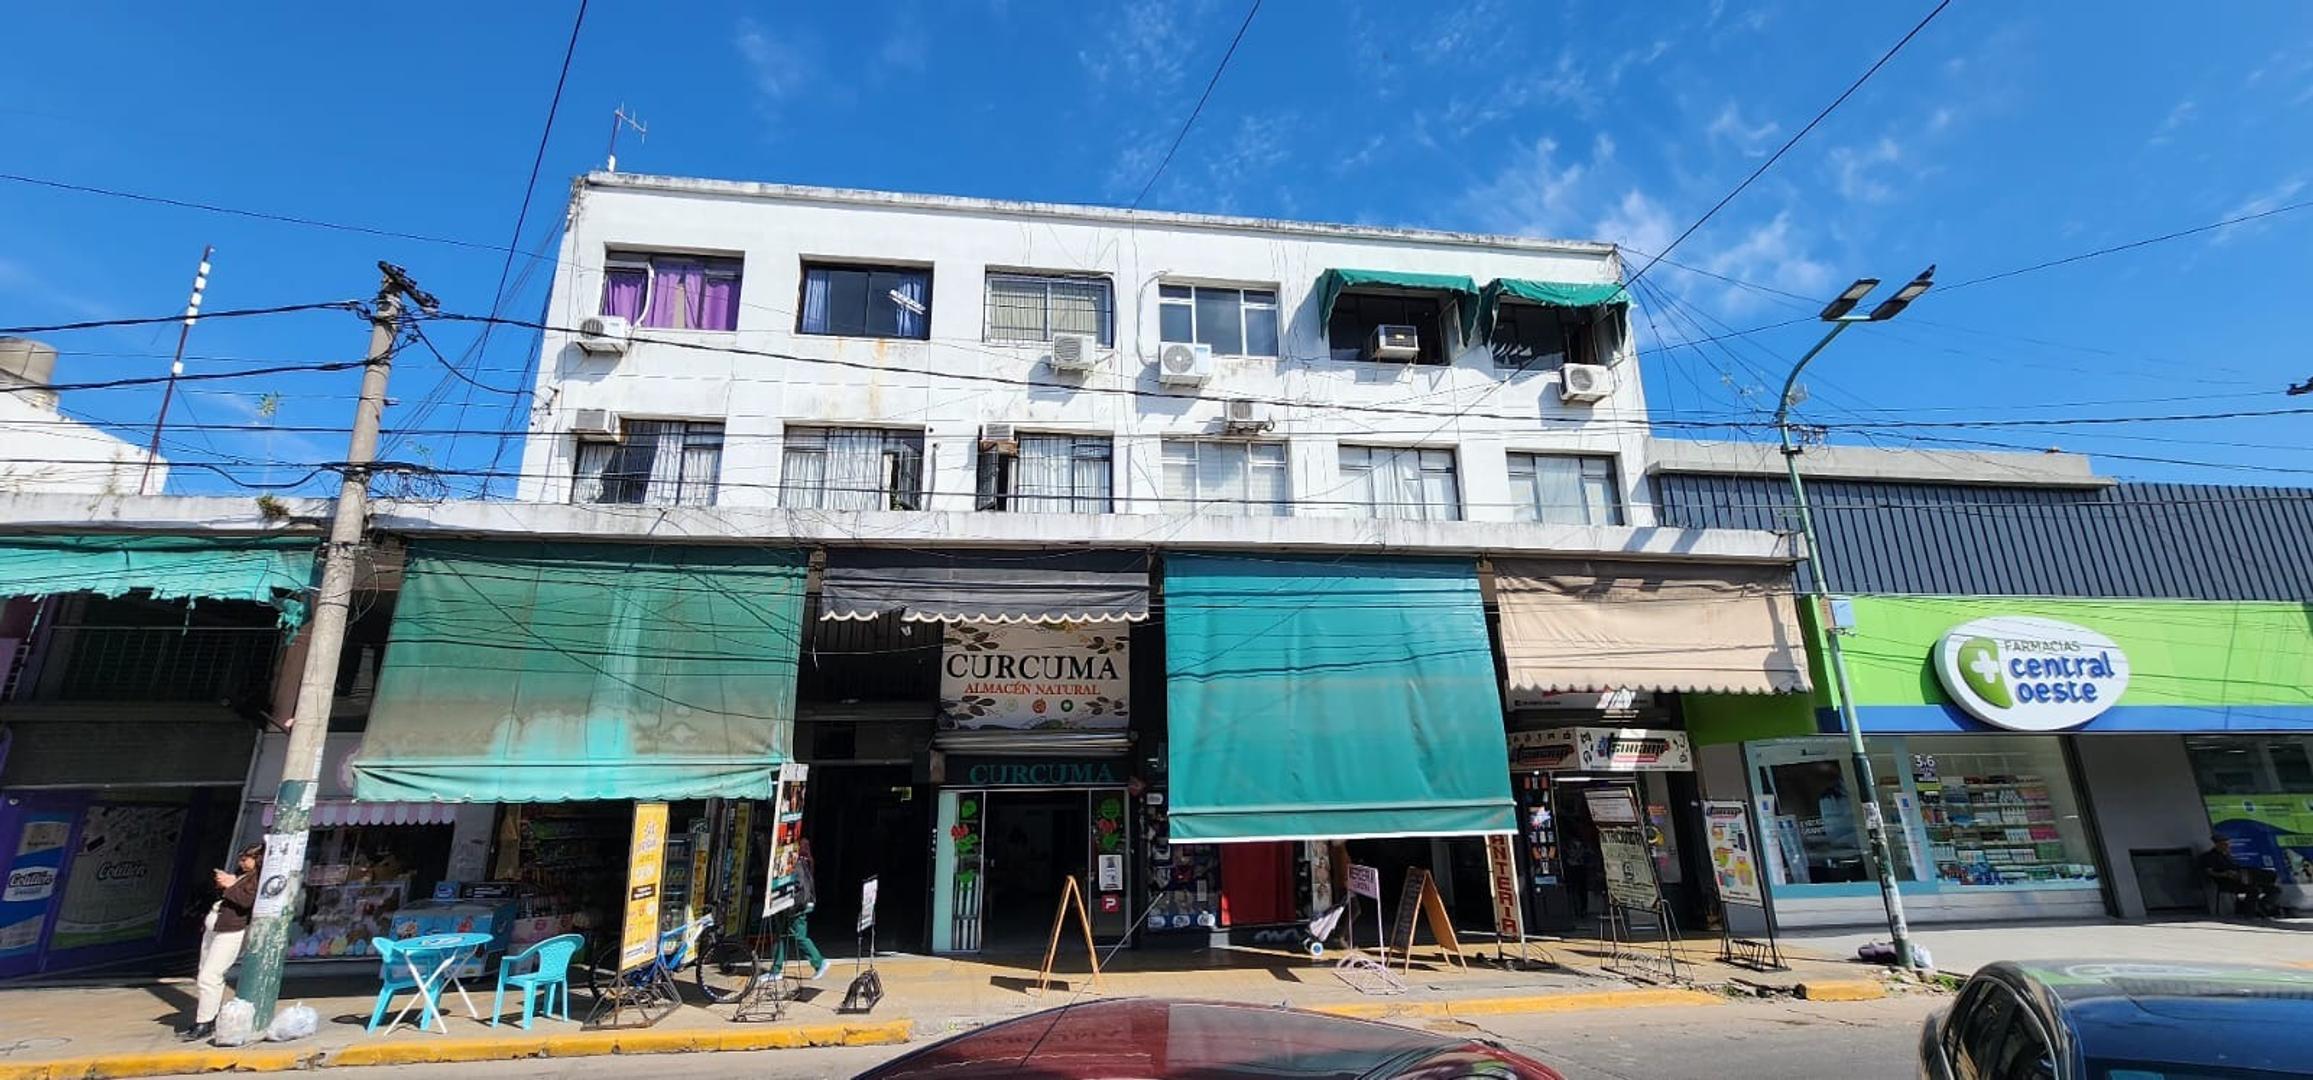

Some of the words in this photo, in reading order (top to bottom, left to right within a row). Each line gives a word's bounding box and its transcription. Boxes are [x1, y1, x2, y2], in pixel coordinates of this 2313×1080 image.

[2003, 640, 2080, 652] FARMACIAS
[946, 653, 1119, 680] CURCUMA
[2009, 651, 2115, 679] central
[965, 681, 1031, 695] ALMACÉN
[1035, 684, 1101, 695] NATURAL
[2016, 681, 2098, 703] oeste
[969, 764, 1115, 784] CURCUMA
